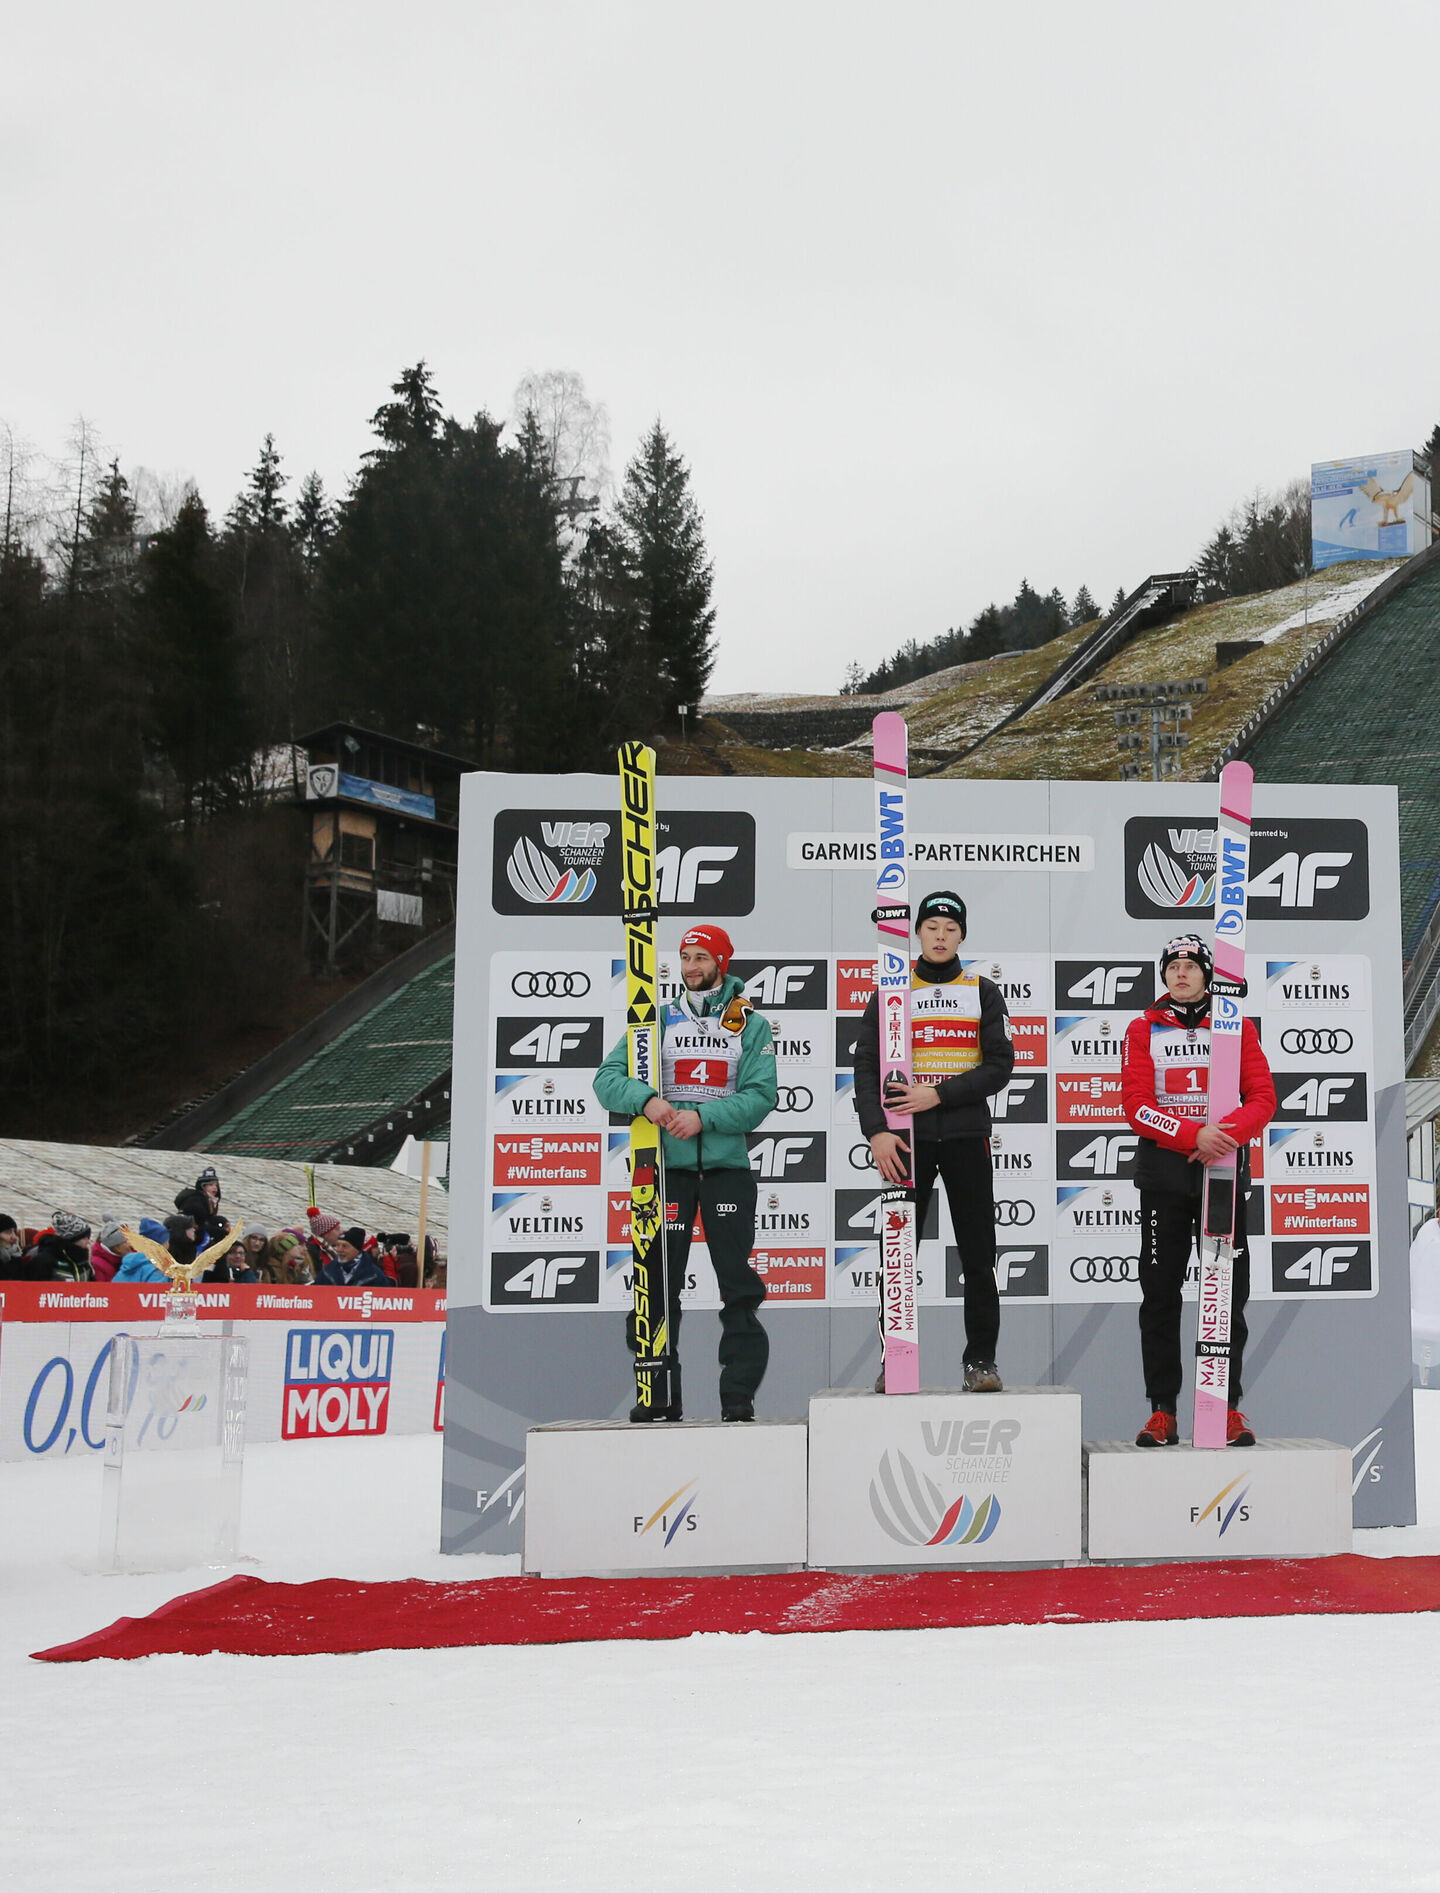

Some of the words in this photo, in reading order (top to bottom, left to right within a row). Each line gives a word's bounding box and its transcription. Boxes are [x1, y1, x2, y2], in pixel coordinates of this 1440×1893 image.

[880, 791, 905, 859] BWT
[540, 821, 611, 848] VIER
[1167, 829, 1218, 853] VIE
[1279, 830, 1289, 839] by
[559, 847, 605, 857] SCHANZEN
[801, 842, 1081, 863] GARMIS-PARTENKIRCHEN
[1186, 853, 1218, 863] SCHANZ
[563, 857, 603, 866] TOURNEE
[1190, 863, 1217, 871] TOURN
[1221, 838, 1246, 906] BWT
[885, 908, 907, 918] BWT
[880, 975, 908, 986] BWT
[1067, 966, 1143, 1005] 4F
[1220, 985, 1241, 995] BWT
[1282, 984, 1351, 1000] VELTINS
[917, 999, 959, 1010] VELTINS
[1213, 1020, 1241, 1031] BWT
[509, 1022, 591, 1063] 4F
[675, 1036, 729, 1049] VELTINS
[911, 1026, 977, 1043] IESSMANN
[773, 1040, 812, 1056] TINS
[1071, 1040, 1123, 1055] VELTI
[1164, 1044, 1210, 1057] VELTIN
[690, 1061, 710, 1084] 4
[1185, 1069, 1203, 1092] 1
[1281, 1078, 1355, 1117] 4F
[512, 1098, 586, 1115] VELTINS
[1069, 1104, 1126, 1117] #Winterf
[1149, 1113, 1177, 1133] LOTOS
[497, 1137, 599, 1160] VIESSMANN
[992, 1153, 1033, 1169] TINS
[1285, 1151, 1354, 1167] VELTINS
[507, 1166, 587, 1180] #Winterfans
[887, 1191, 907, 1200] BWT
[1273, 1188, 1368, 1210] VIESSMANN
[509, 1216, 584, 1234] VELTINS
[754, 1213, 810, 1230] ELTINS
[1284, 1216, 1358, 1229] #Winterfans
[747, 1252, 824, 1275] ESSMANN
[1284, 1246, 1359, 1286] 4F
[504, 1256, 587, 1299] 4F
[766, 1281, 813, 1294] terfans
[904, 1252, 914, 1331] MINERALIZED
[1220, 1267, 1231, 1308] WATER
[39, 1293, 110, 1309] #Winterfans
[256, 1294, 314, 1310] #Winterfans
[336, 1291, 414, 1319] VIESSMANN
[1200, 1265, 1219, 1386] MANESIUM
[1209, 1346, 1231, 1355] BWT
[1217, 1310, 1229, 1387] MINELIZED
[289, 1332, 390, 1383] LIQUI
[286, 1386, 390, 1436] MOLY
[920, 1419, 1022, 1456] VIER
[945, 1456, 1012, 1471] SCHANZEN
[951, 1470, 1009, 1485] TOURNEE
